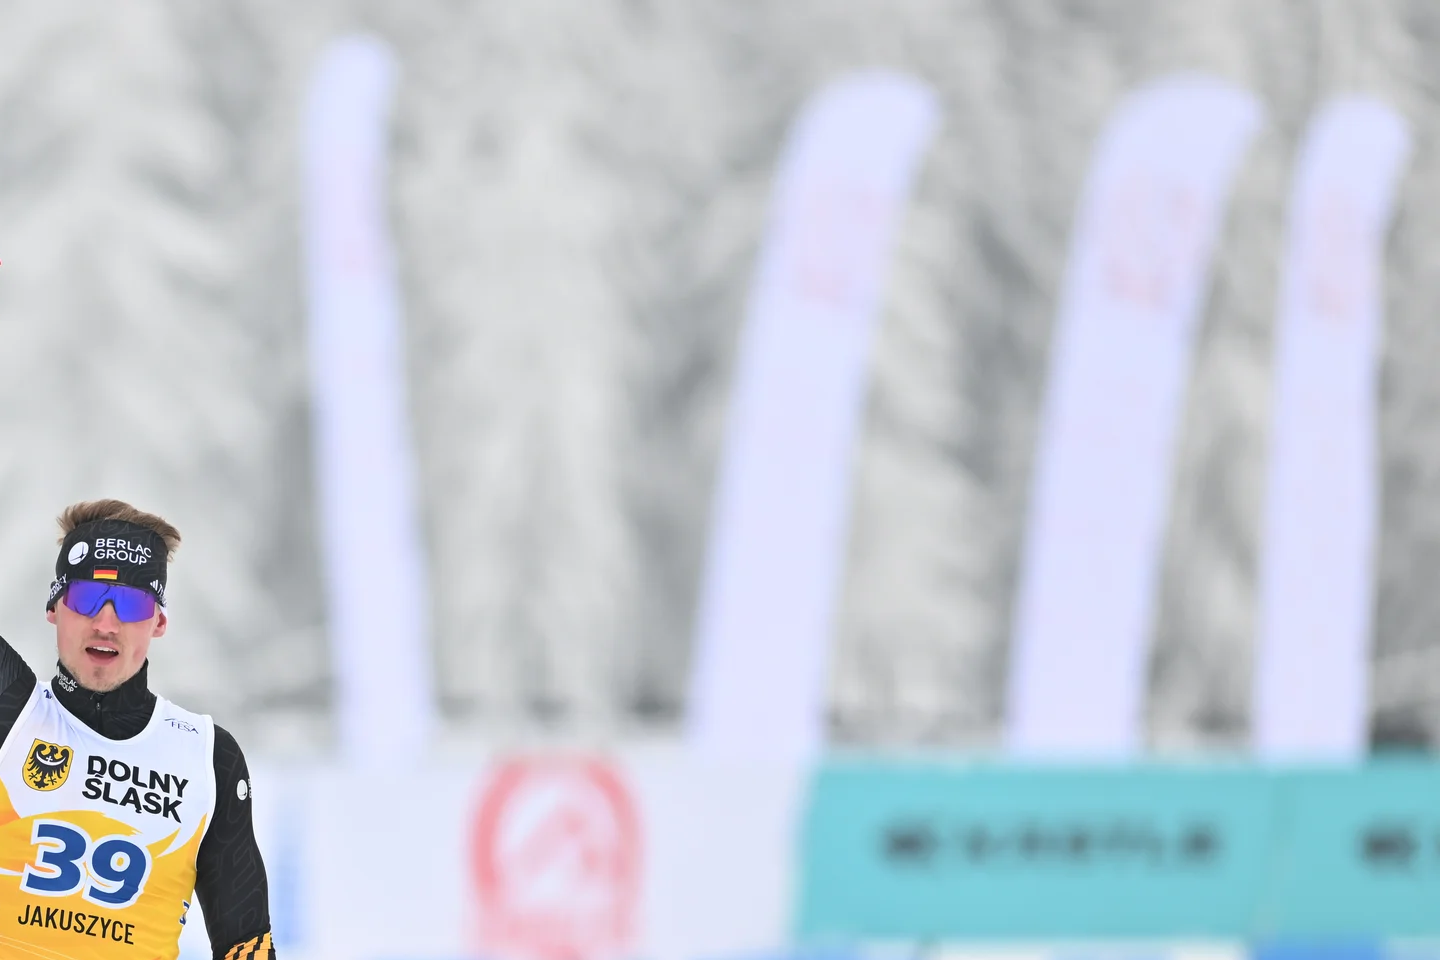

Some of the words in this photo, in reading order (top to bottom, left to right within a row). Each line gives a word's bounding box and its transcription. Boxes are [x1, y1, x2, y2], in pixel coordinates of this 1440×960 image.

[94, 548, 148, 566] GROUP
[95, 538, 152, 559] BERLAC
[171, 721, 199, 735] FESA
[87, 755, 189, 798] DOLNY
[82, 773, 183, 824] ŚLĄSK
[23, 822, 149, 906] 39
[17, 904, 136, 946] JAKUSZYCE
